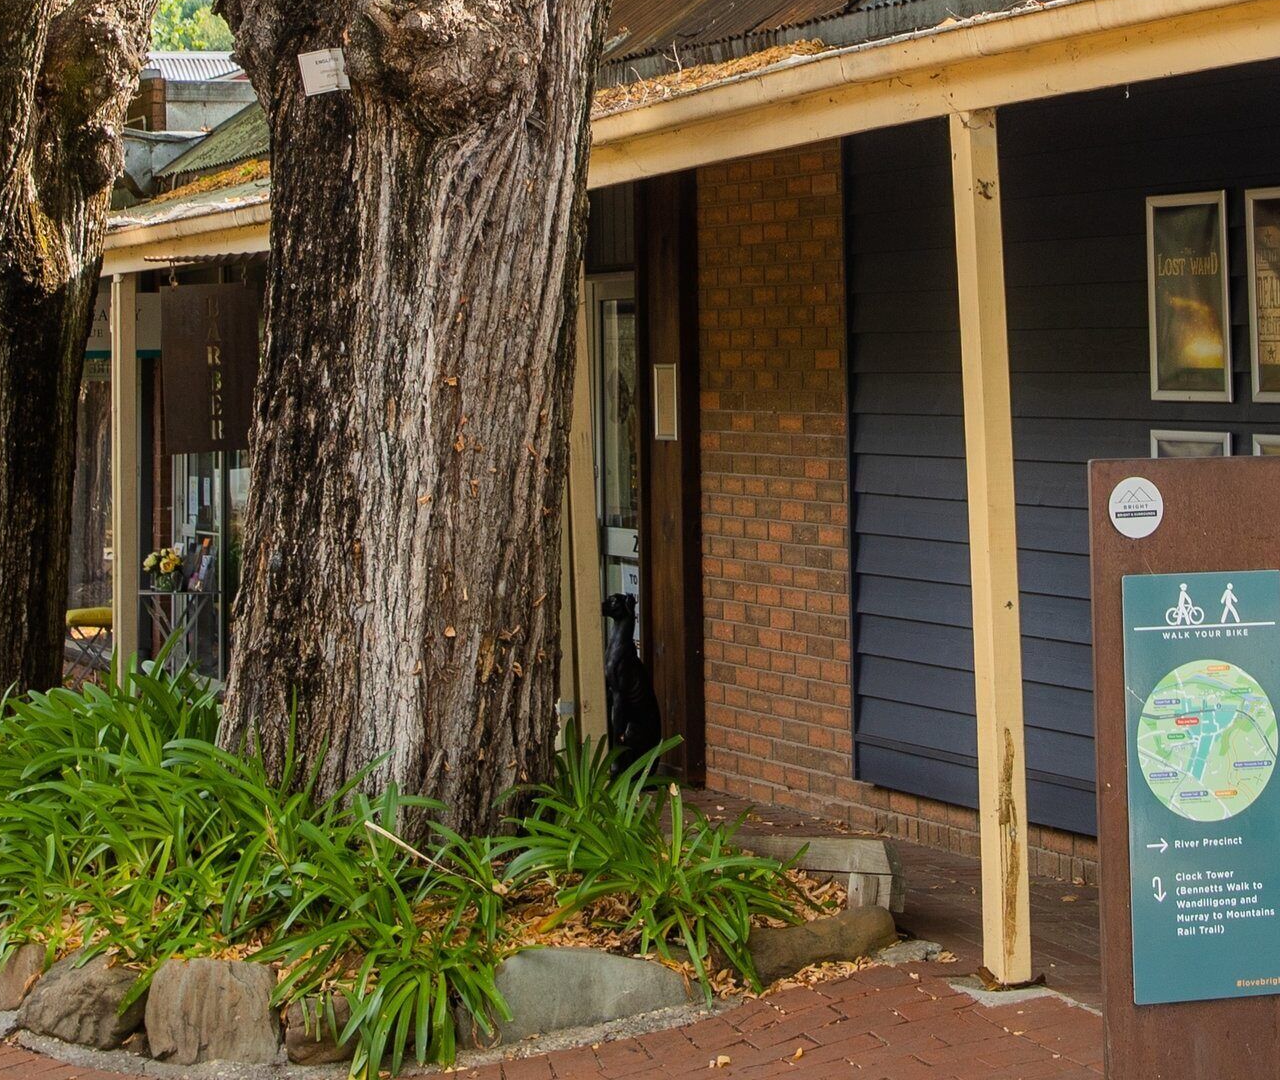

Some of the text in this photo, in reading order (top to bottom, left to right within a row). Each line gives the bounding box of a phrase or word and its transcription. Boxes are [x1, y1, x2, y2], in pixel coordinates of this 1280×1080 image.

[1157, 251, 1218, 276] LOST WAND
[1162, 628, 1249, 640] WALK YOUR BIKE
[1174, 836, 1243, 849] River Precinct
[1175, 870, 1234, 882] Clock Tower
[1176, 882, 1263, 896] (Bennetts Walk to
[1176, 895, 1258, 909] Wandiligong and
[1176, 908, 1275, 923] Murray to Mountains
[1177, 924, 1225, 936] Rail Trail)
